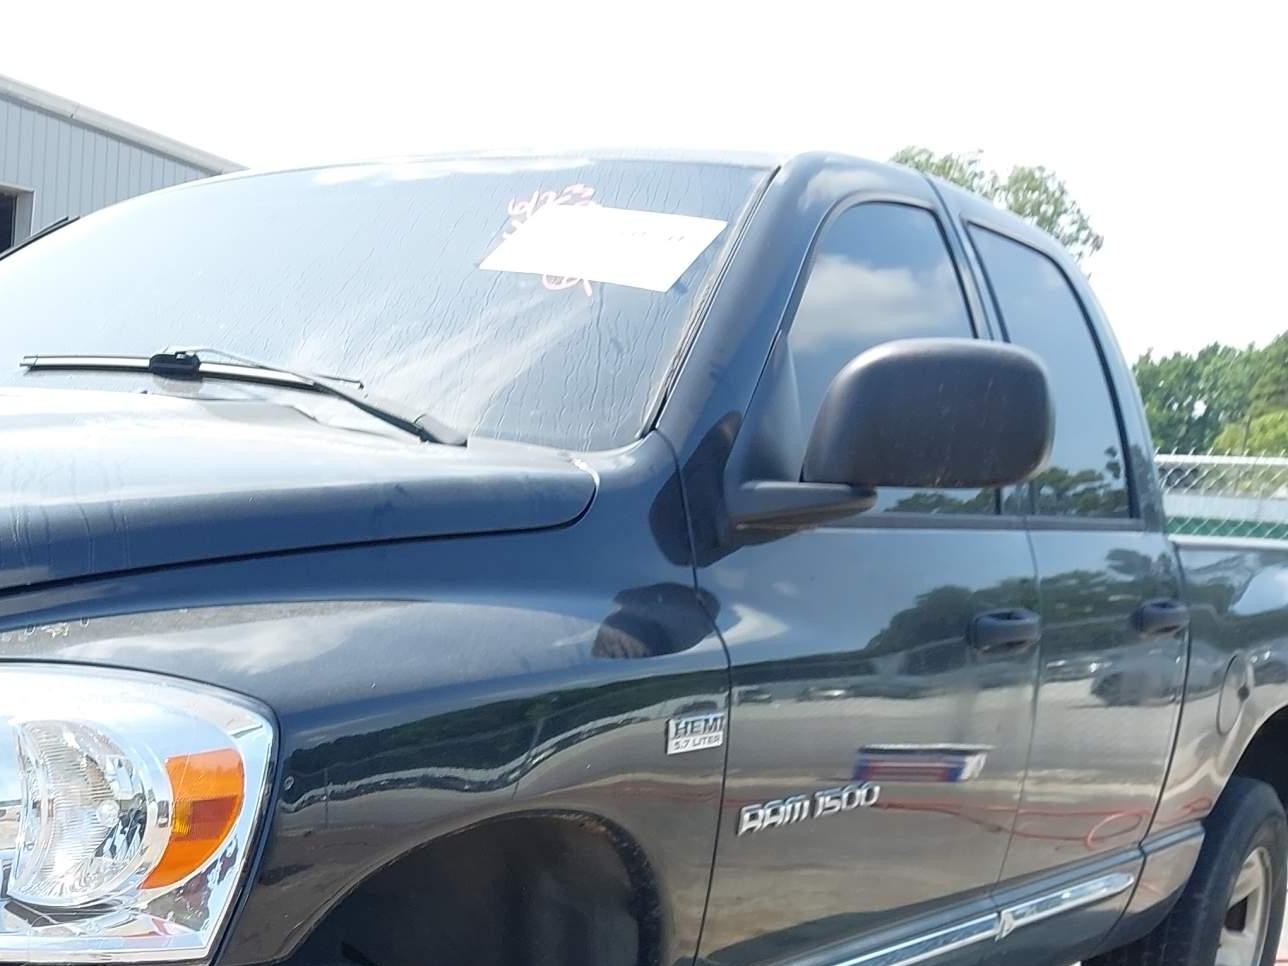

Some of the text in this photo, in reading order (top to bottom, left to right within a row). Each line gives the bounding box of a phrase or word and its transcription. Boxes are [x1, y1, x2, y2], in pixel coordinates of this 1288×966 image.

[674, 716, 725, 738] HEMI
[673, 735, 721, 751] 5.7 LITER
[736, 781, 881, 837] RAM 1500
